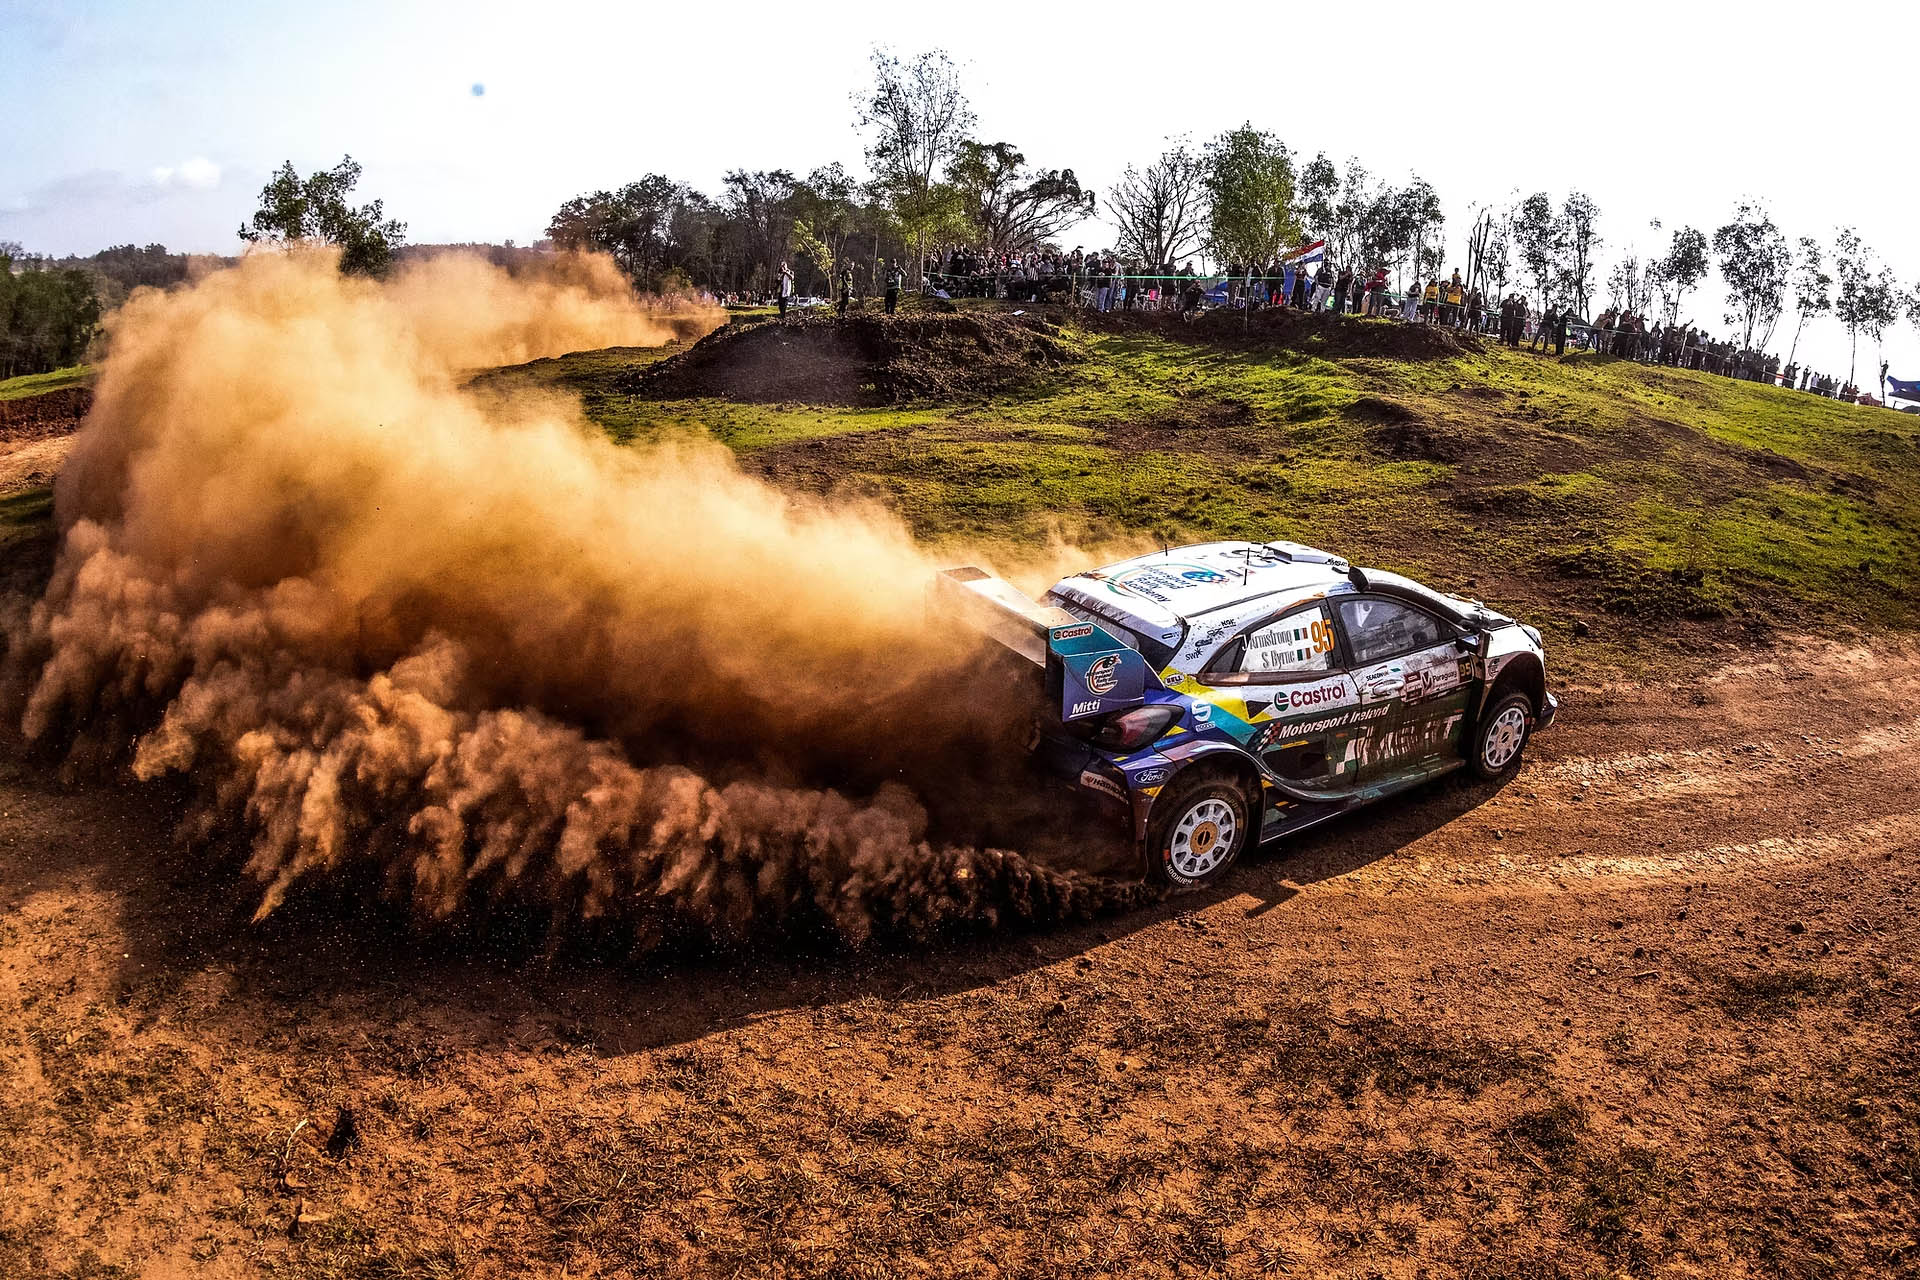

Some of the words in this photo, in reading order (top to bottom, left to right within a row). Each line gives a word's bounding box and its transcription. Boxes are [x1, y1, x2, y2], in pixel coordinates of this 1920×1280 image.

[1062, 626, 1092, 638] Castrol
[1250, 629, 1293, 650] Armstrong
[1311, 619, 1335, 653] 95
[1262, 651, 1270, 668] S
[1271, 650, 1295, 669] Byrne
[1460, 663, 1472, 676] 95
[1291, 682, 1346, 707] Castrol
[1072, 700, 1100, 714] Mitti
[1279, 712, 1349, 739] Motorsport
[1350, 704, 1391, 723] Ireland
[1140, 770, 1164, 781] Ford
[1167, 864, 1193, 885] Hankook
